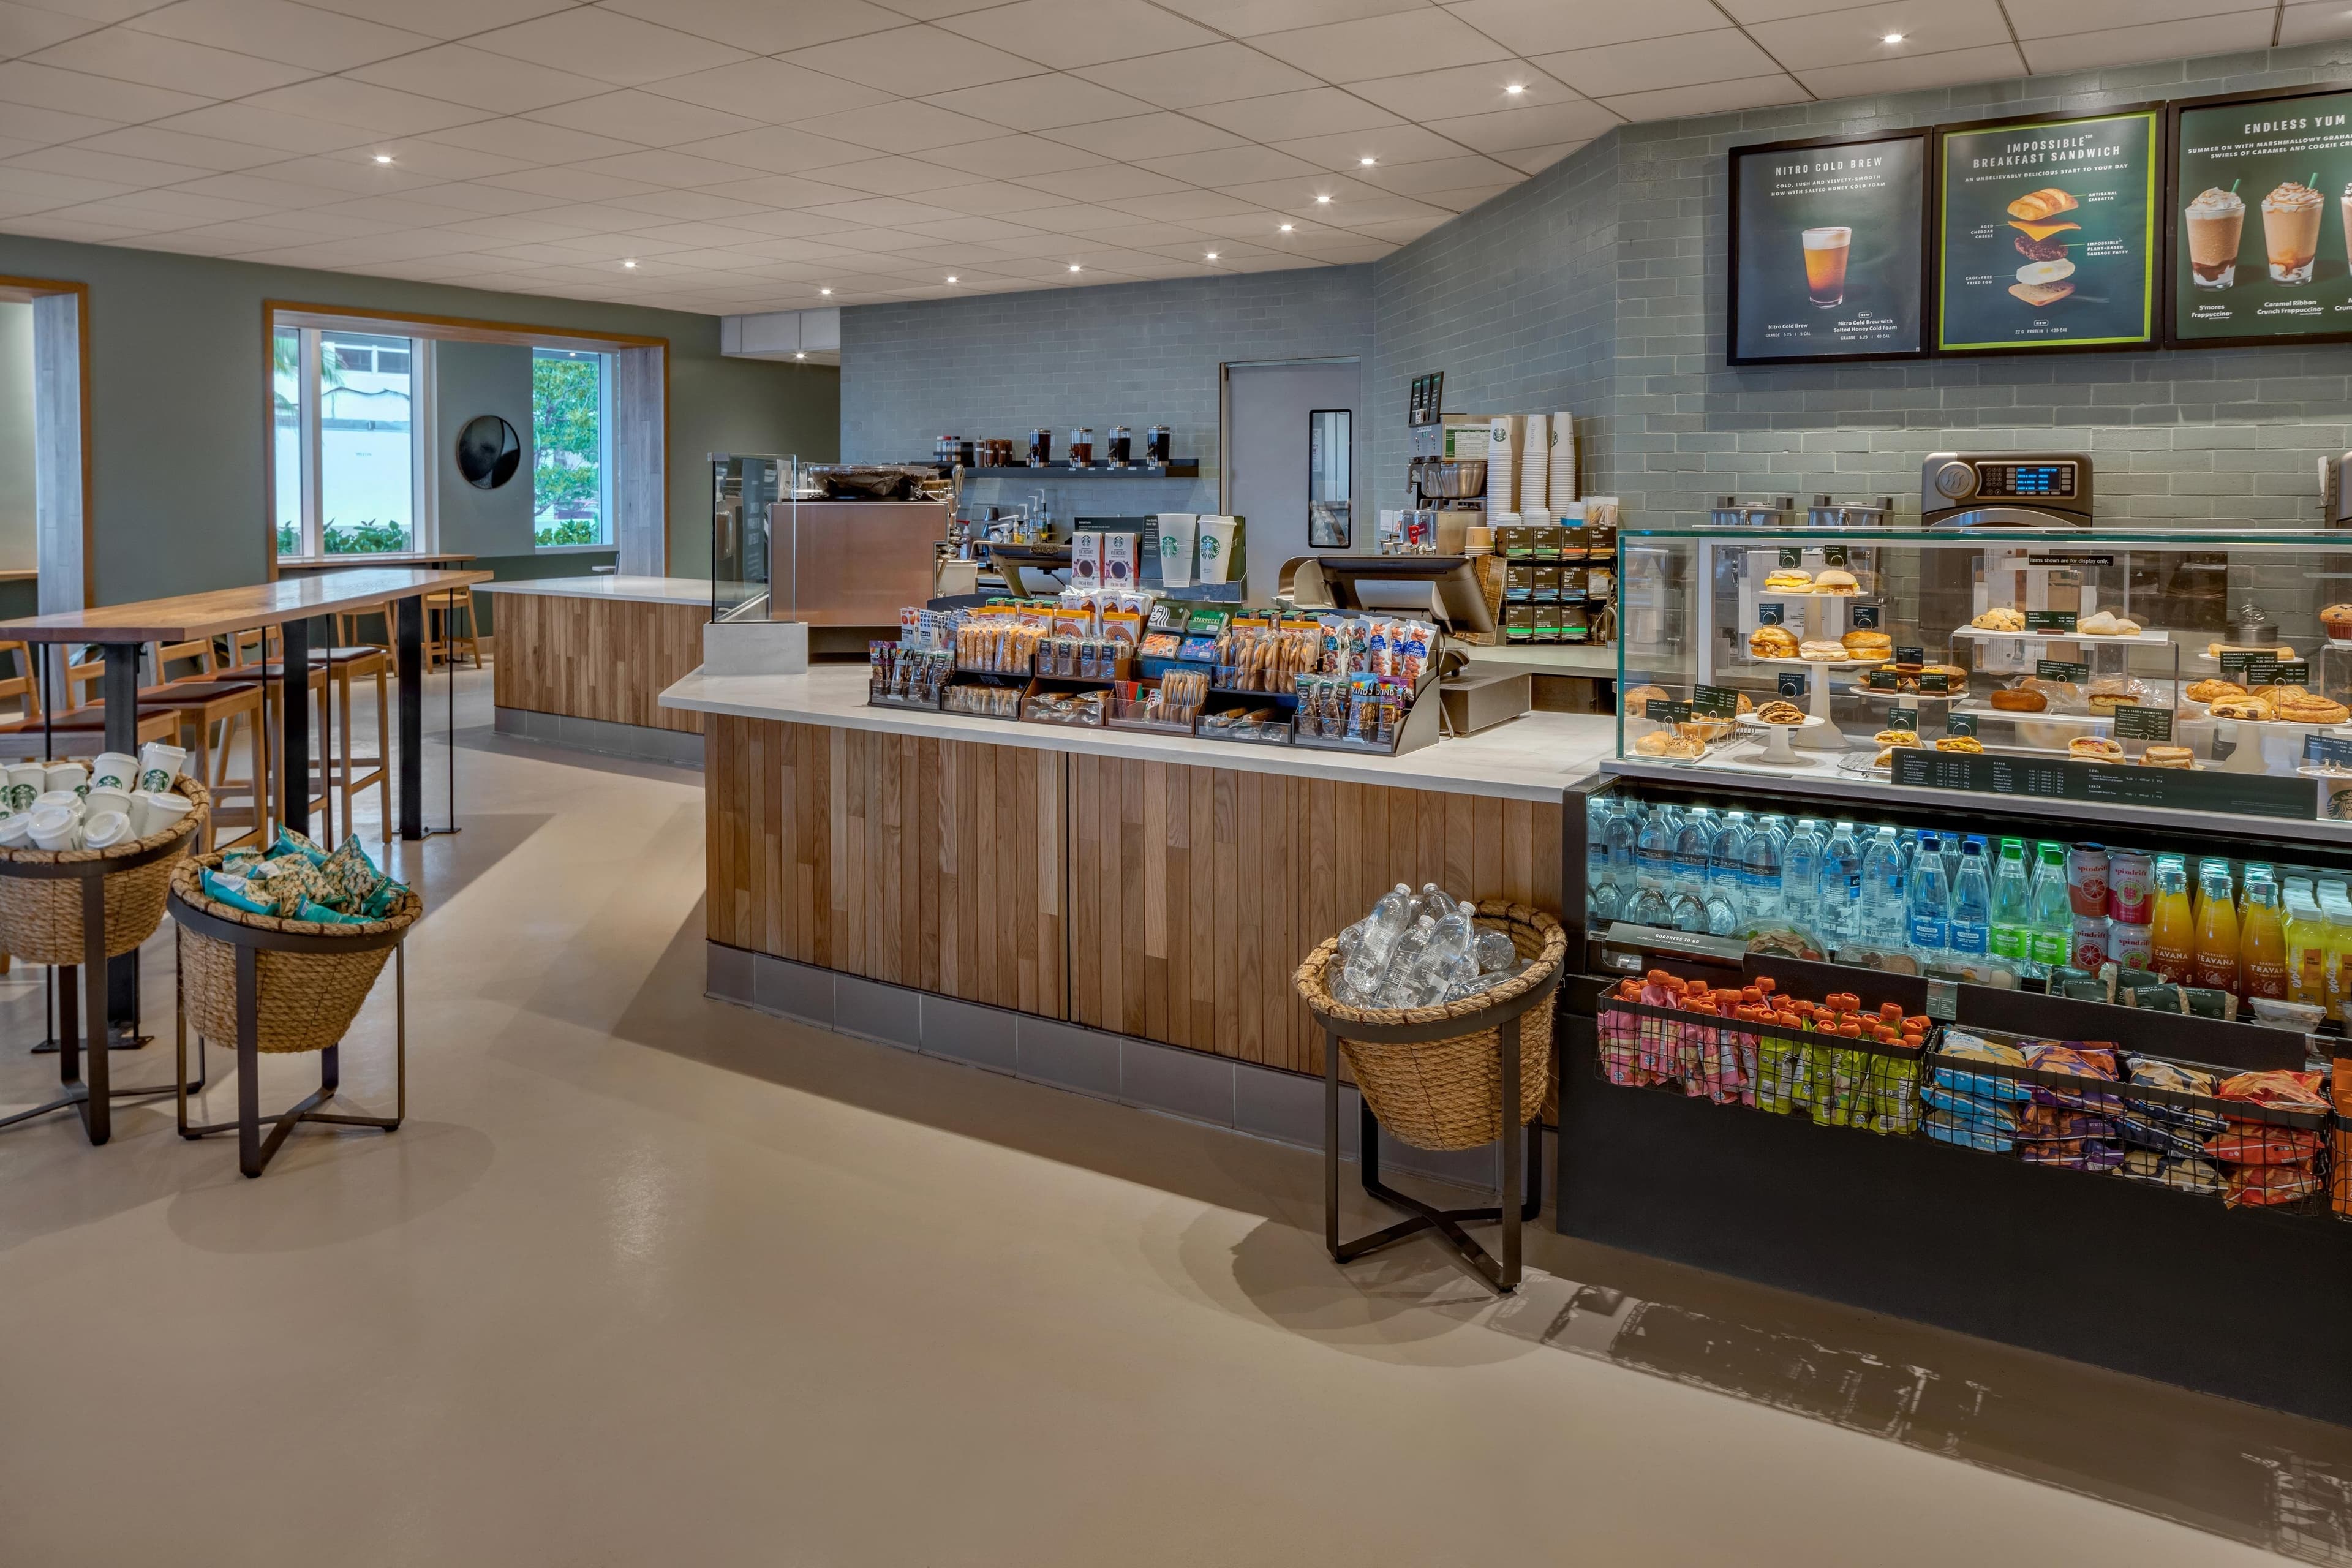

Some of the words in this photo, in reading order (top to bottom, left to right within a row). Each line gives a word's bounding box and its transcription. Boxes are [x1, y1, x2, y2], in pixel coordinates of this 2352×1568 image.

[2244, 118, 2307, 134] ENDLESS
[2315, 115, 2345, 127] YUM
[2256, 137, 2321, 148] MARSHMALLOWY
[1973, 153, 2045, 168] BREAKFAST
[2051, 146, 2120, 162] SANDWICH
[1776, 164, 1809, 176] NITRO
[1815, 161, 1843, 172] COLD
[1850, 157, 1882, 168] BREW
[1826, 175, 1881, 184] VELVETY-SMOOTH
[1193, 616, 1221, 625] STARBUCKS
[2115, 869, 2147, 877] spindrift
[2075, 930, 2106, 939] spindrift
[2196, 954, 2235, 966] TEAVANA
[2250, 964, 2285, 974] TEAVAN
